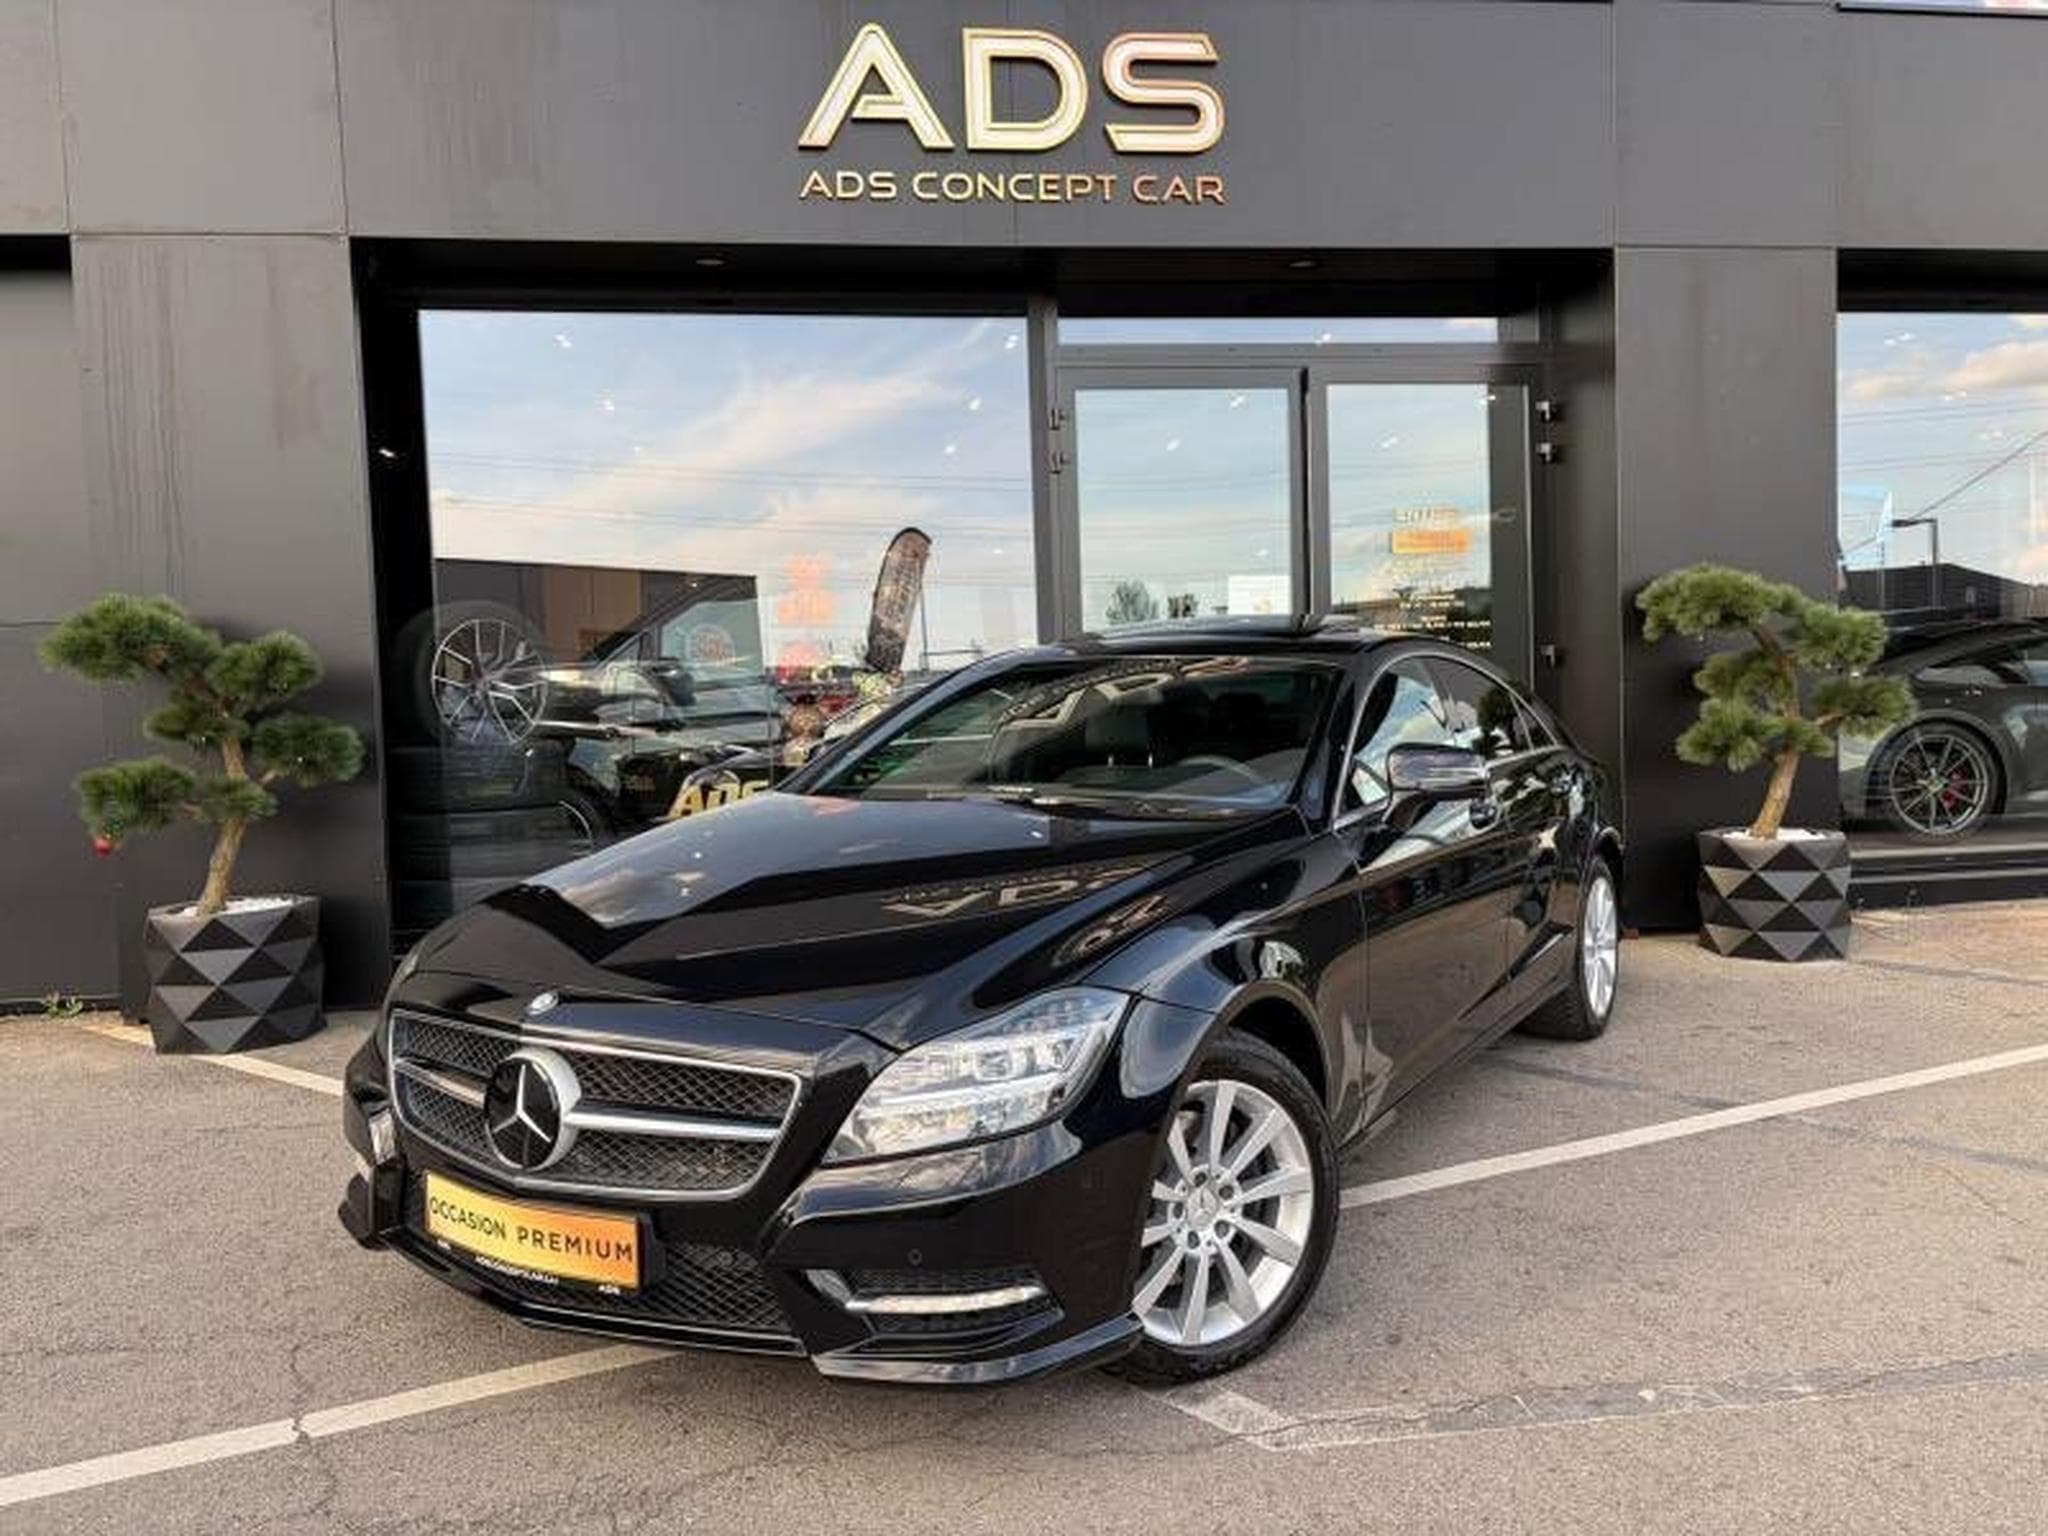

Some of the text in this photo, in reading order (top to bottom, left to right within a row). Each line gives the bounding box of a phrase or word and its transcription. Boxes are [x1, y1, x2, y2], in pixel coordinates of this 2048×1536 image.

[798, 22, 1226, 153] ADS
[799, 169, 1226, 205] ADS CONCEPT CAR
[429, 1196, 634, 1263] OCCASION PREMIUM
